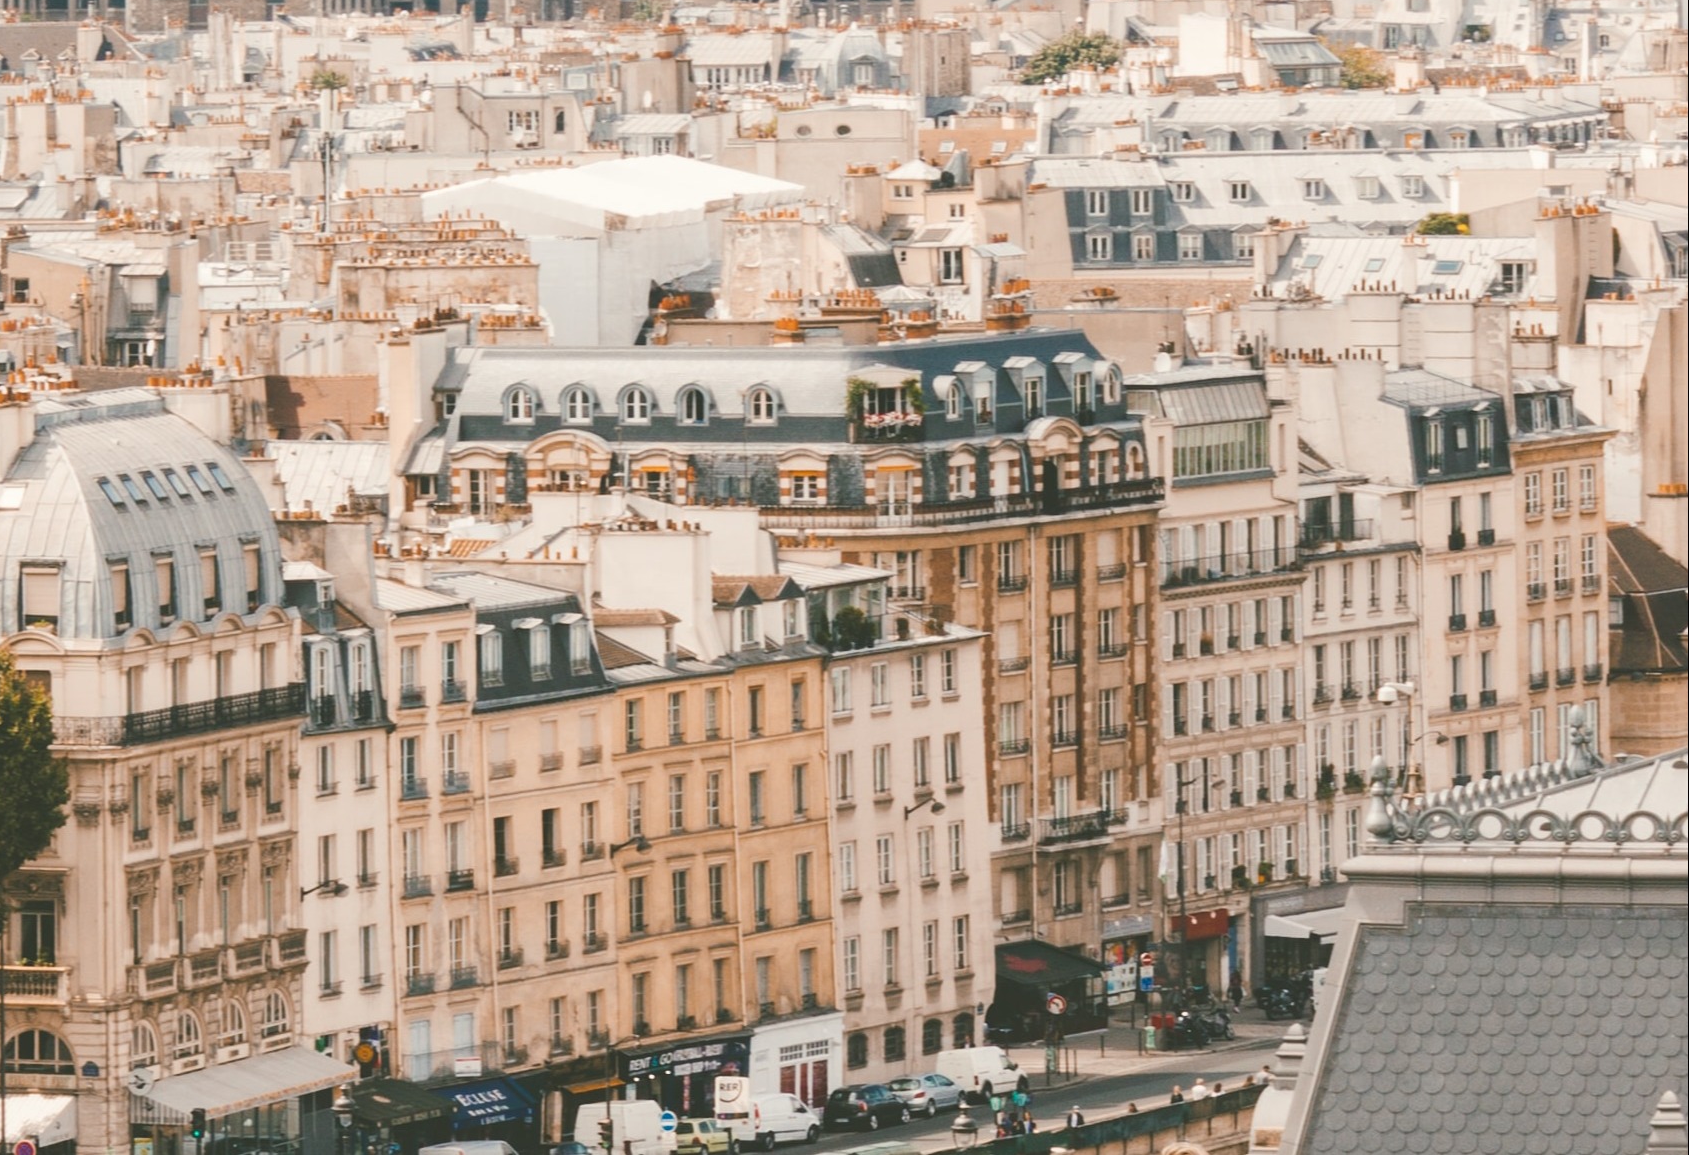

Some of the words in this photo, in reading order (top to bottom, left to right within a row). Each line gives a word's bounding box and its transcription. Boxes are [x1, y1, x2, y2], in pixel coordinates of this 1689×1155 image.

[629, 1057, 652, 1071] RENT
[659, 1053, 673, 1065] GO
[719, 1083, 738, 1091] RER
